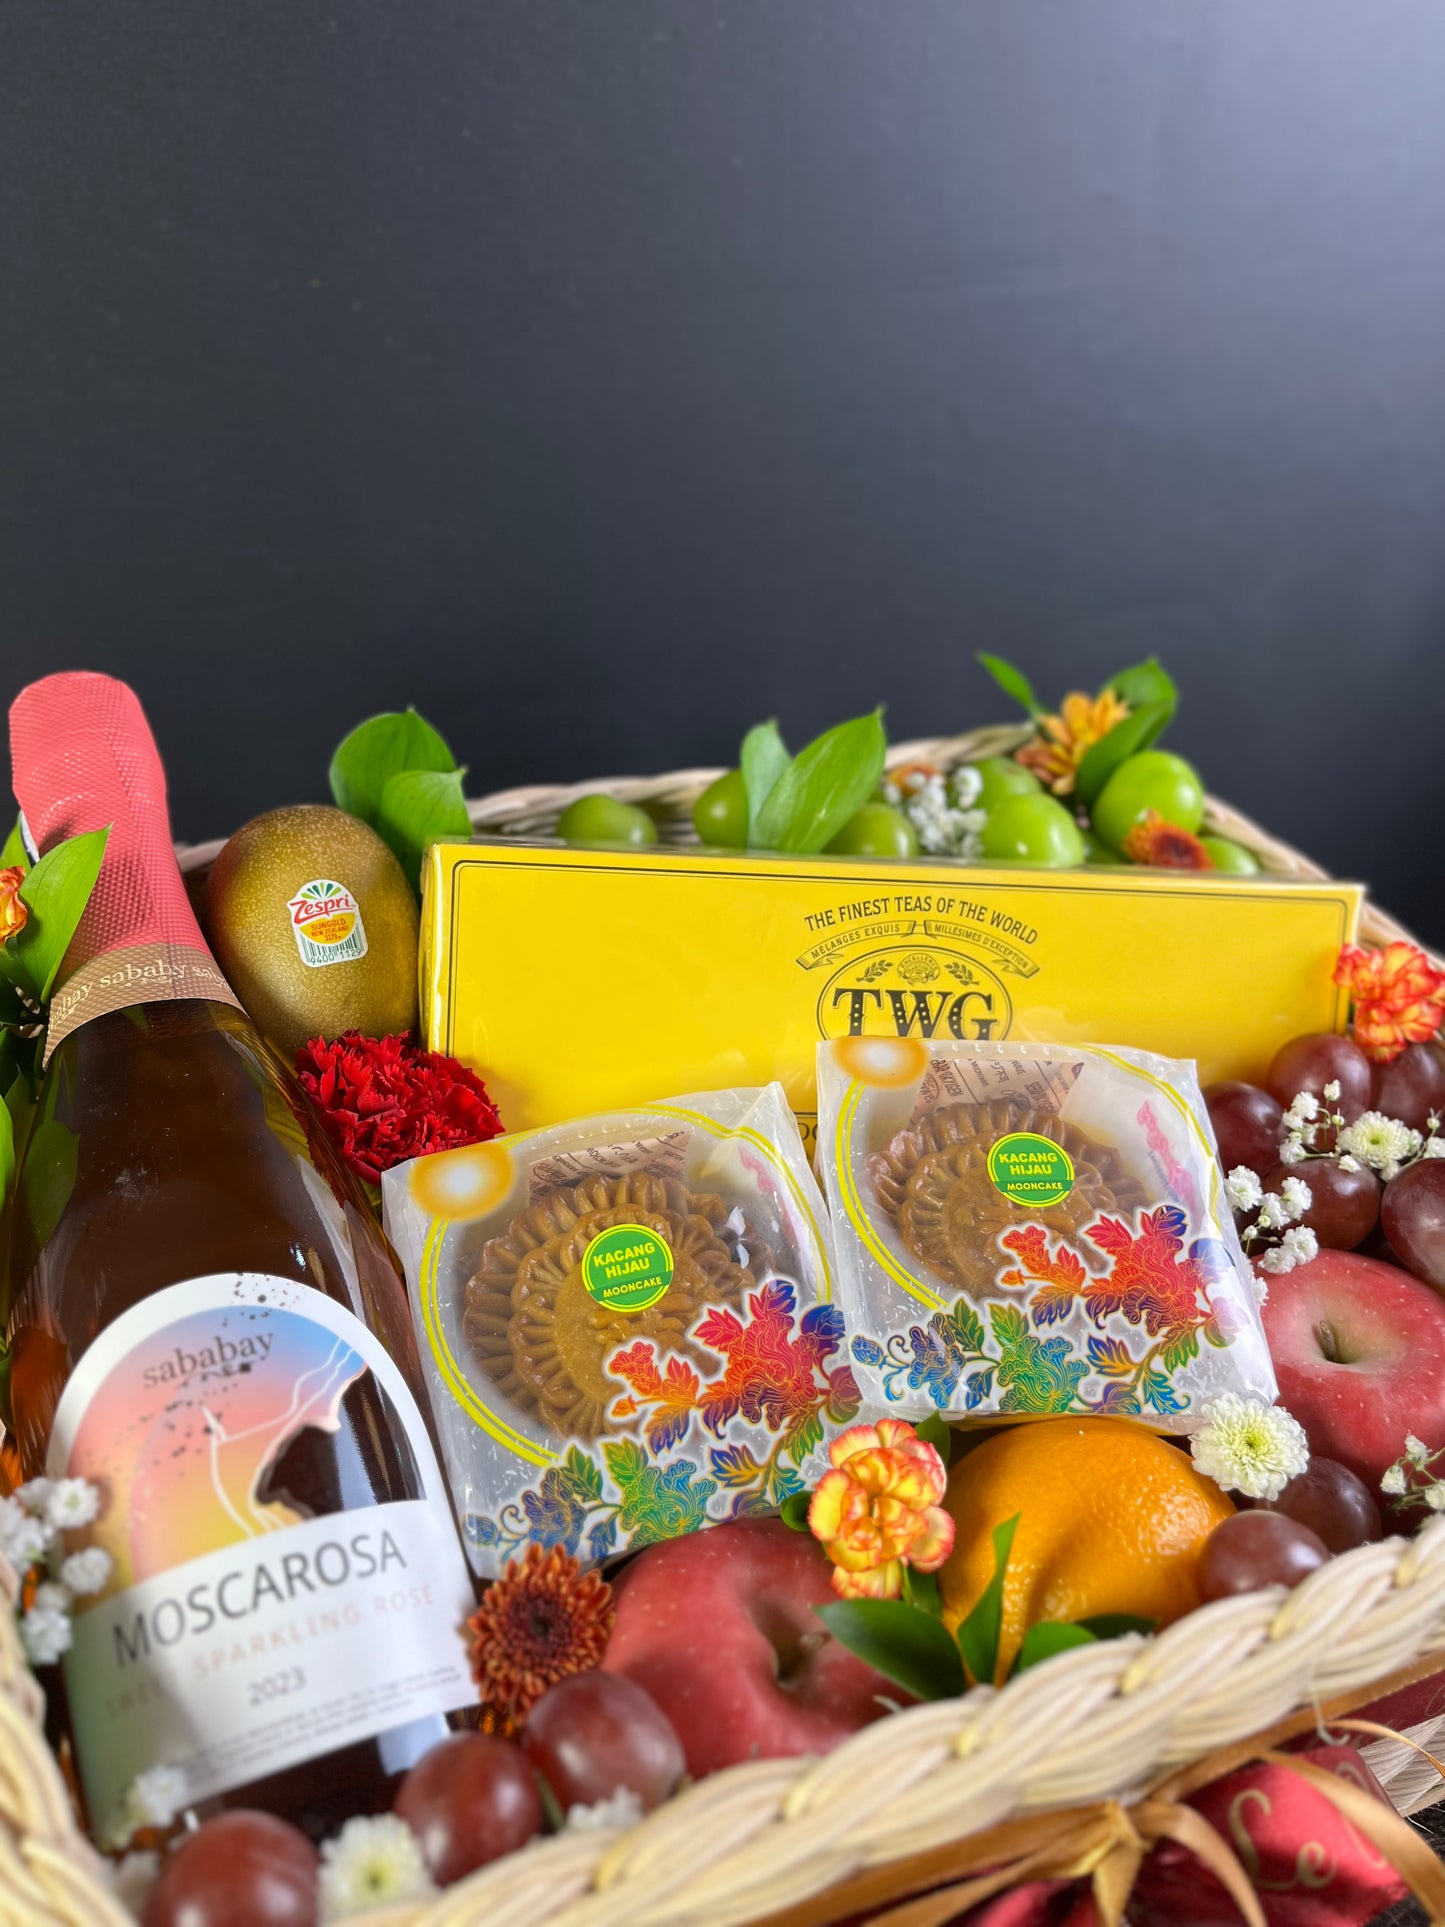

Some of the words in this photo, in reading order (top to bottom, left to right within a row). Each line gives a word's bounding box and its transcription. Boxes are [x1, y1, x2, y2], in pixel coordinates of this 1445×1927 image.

[290, 894, 354, 925] Zespri
[804, 909, 836, 932] THE
[838, 898, 890, 922] FINEST
[894, 896, 932, 912] TEAS
[936, 897, 956, 914] OF
[959, 900, 988, 922] THE
[990, 910, 1038, 945] WORLD
[310, 917, 347, 931] SUNGOLD
[864, 924, 900, 937] EXQUIS
[310, 953, 335, 965] 9400
[832, 987, 998, 1041] TWG
[998, 1152, 1058, 1164] KACANG
[1009, 1164, 1053, 1175] HIJAU
[1007, 1182, 1063, 1191] MOONCAKE
[593, 1242, 656, 1267] KACANG
[605, 1257, 650, 1279] HIJAU
[602, 1276, 662, 1298] MOONCAKE
[142, 1332, 274, 1389] sababay
[113, 1529, 408, 1669] MOSCAROSA
[195, 1602, 363, 1681] SPARKLING
[248, 1665, 308, 1707] 2023
